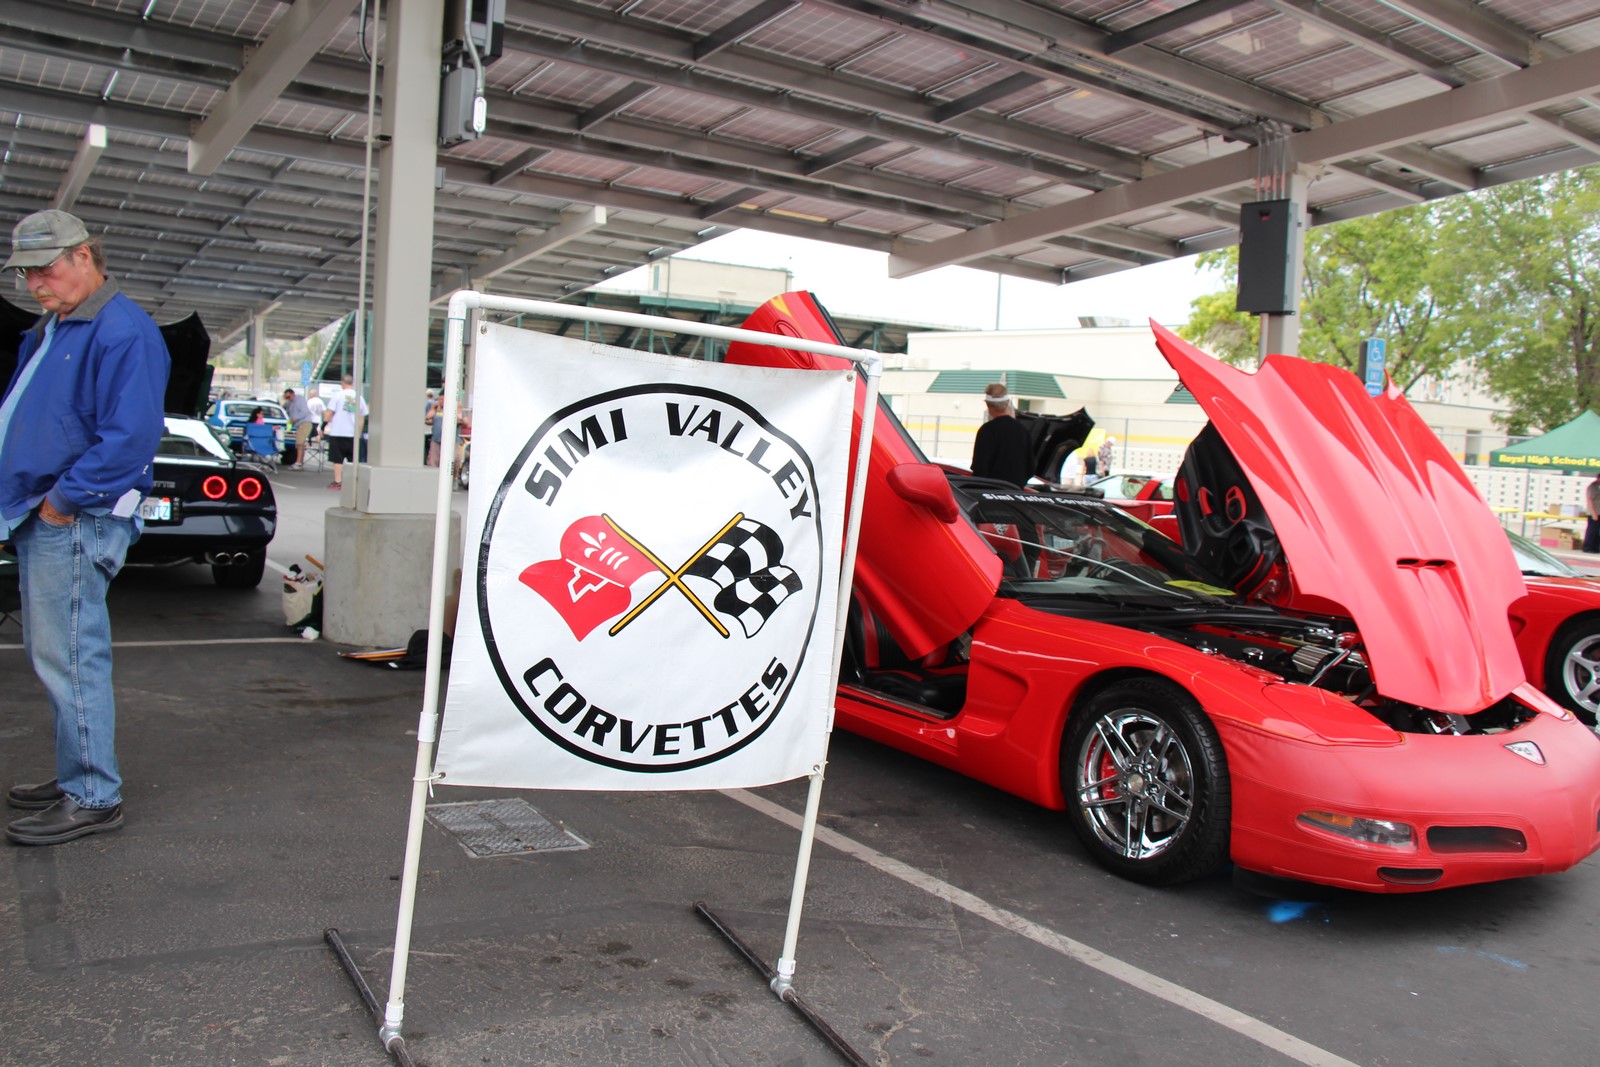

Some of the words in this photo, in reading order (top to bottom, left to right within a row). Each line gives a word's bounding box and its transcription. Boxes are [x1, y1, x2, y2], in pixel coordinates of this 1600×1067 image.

[525, 408, 628, 506] SIMI
[665, 402, 811, 521] VALLEY
[1499, 454, 1526, 464] Royal
[1527, 455, 1550, 465] High
[1552, 456, 1587, 466] School
[523, 656, 788, 756] CORVETTES
